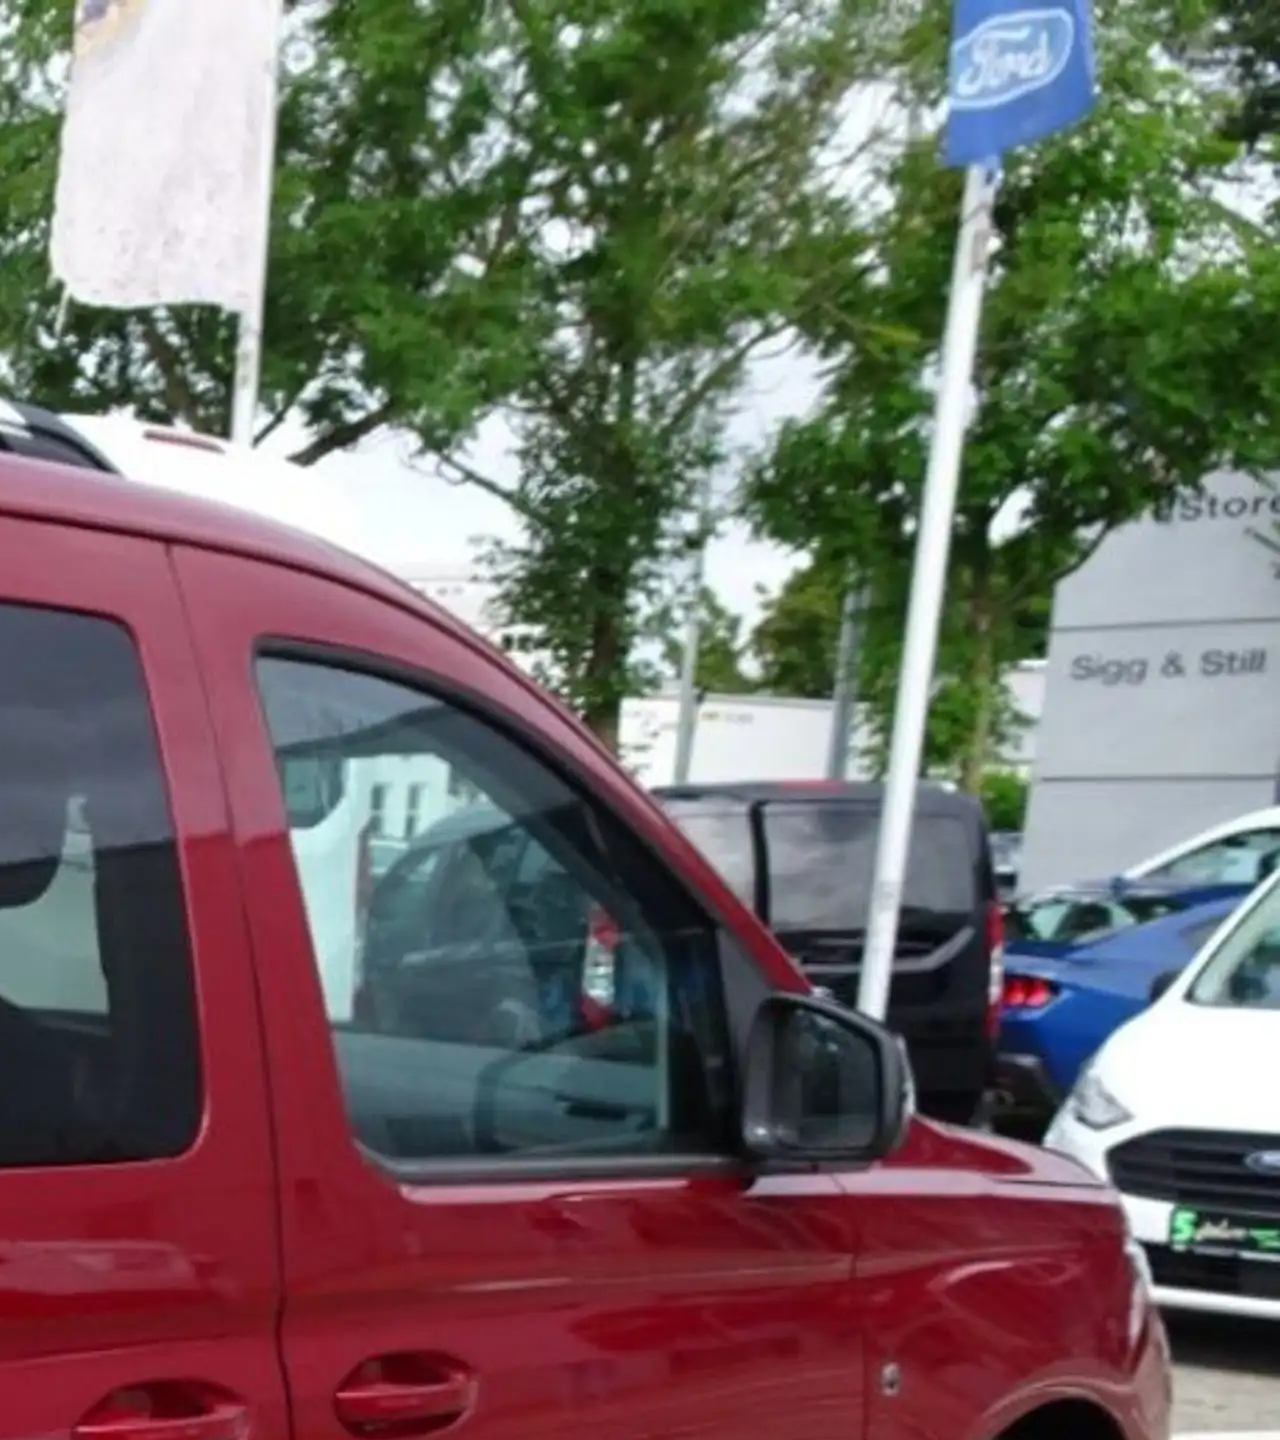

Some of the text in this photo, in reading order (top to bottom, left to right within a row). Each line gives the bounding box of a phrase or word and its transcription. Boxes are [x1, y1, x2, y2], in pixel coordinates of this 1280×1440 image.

[957, 27, 1050, 97] Ford
[1070, 647, 1268, 686] Sigg & Still
